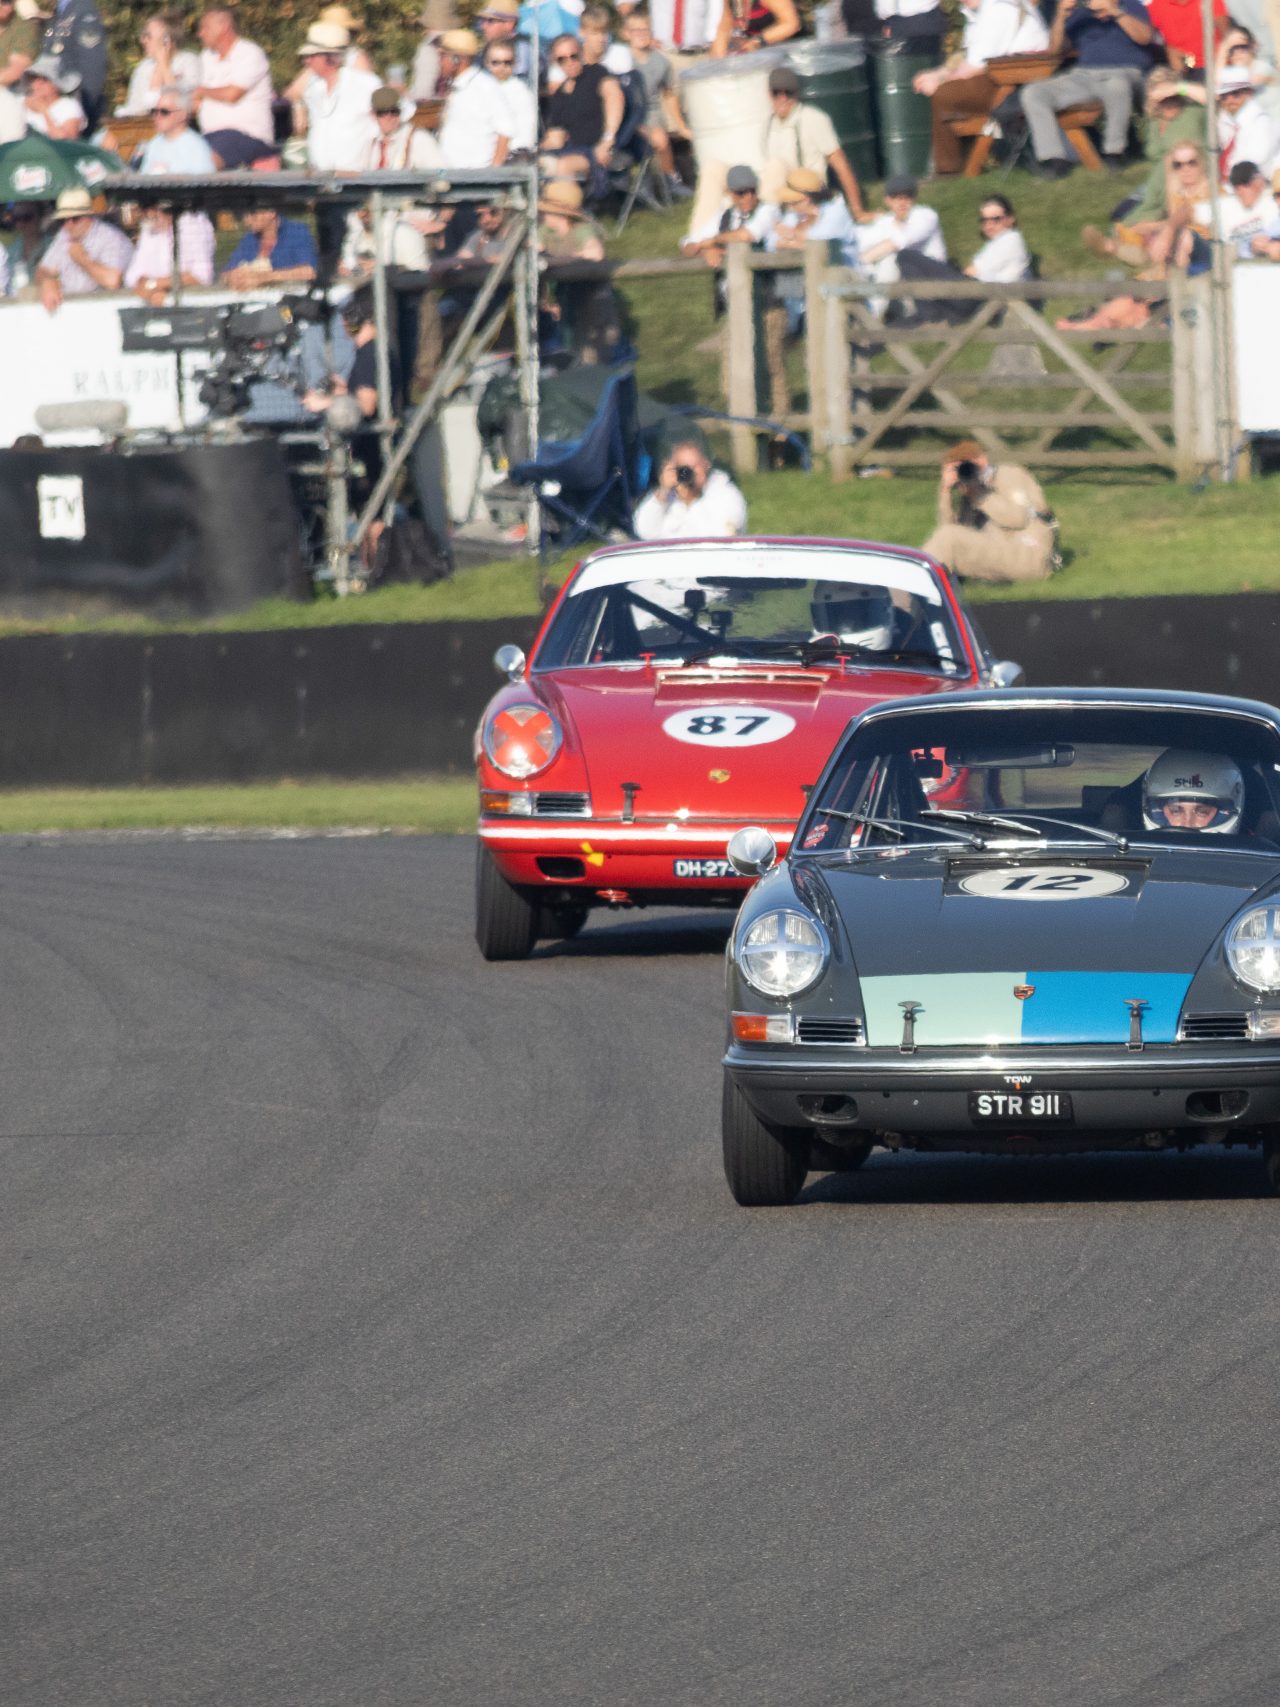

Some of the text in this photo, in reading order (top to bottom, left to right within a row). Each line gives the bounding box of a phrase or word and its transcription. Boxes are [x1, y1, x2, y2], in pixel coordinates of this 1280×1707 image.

[47, 495, 80, 519] TV
[687, 715, 771, 735] 87
[1002, 874, 1093, 891] 12
[1003, 1075, 1033, 1083] TOW
[977, 1095, 1060, 1115] STR 911
